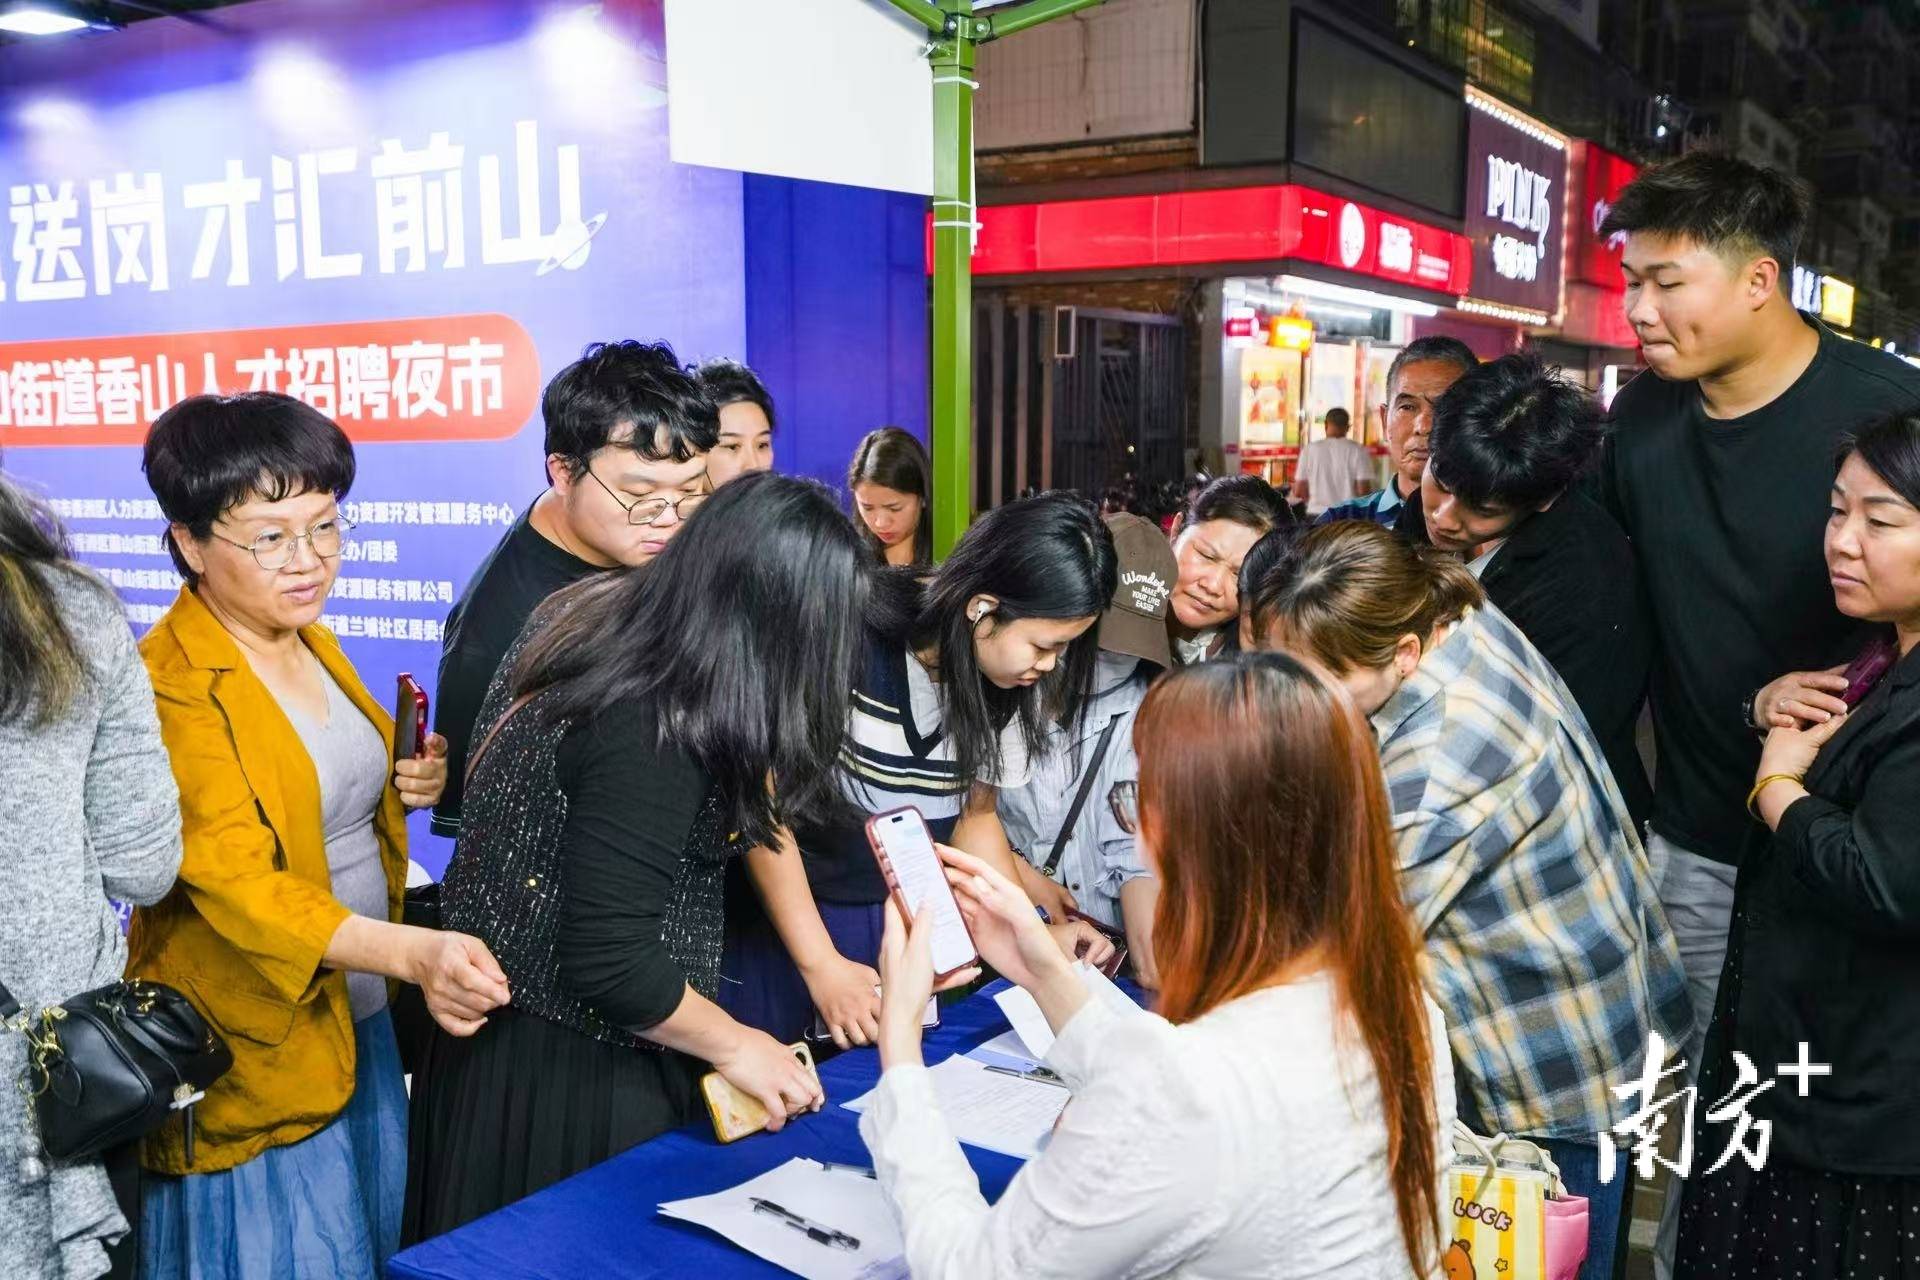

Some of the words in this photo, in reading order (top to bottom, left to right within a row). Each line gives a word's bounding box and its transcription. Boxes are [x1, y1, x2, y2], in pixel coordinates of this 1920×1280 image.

[0, 119, 583, 302] 送岗才汇前山
[0, 337, 503, 427] 街道香山人才招聘夜市
[328, 577, 453, 603] 资源服务有限公司
[1132, 590, 1148, 602] YOUR
[1453, 1197, 1513, 1232] LUCK
